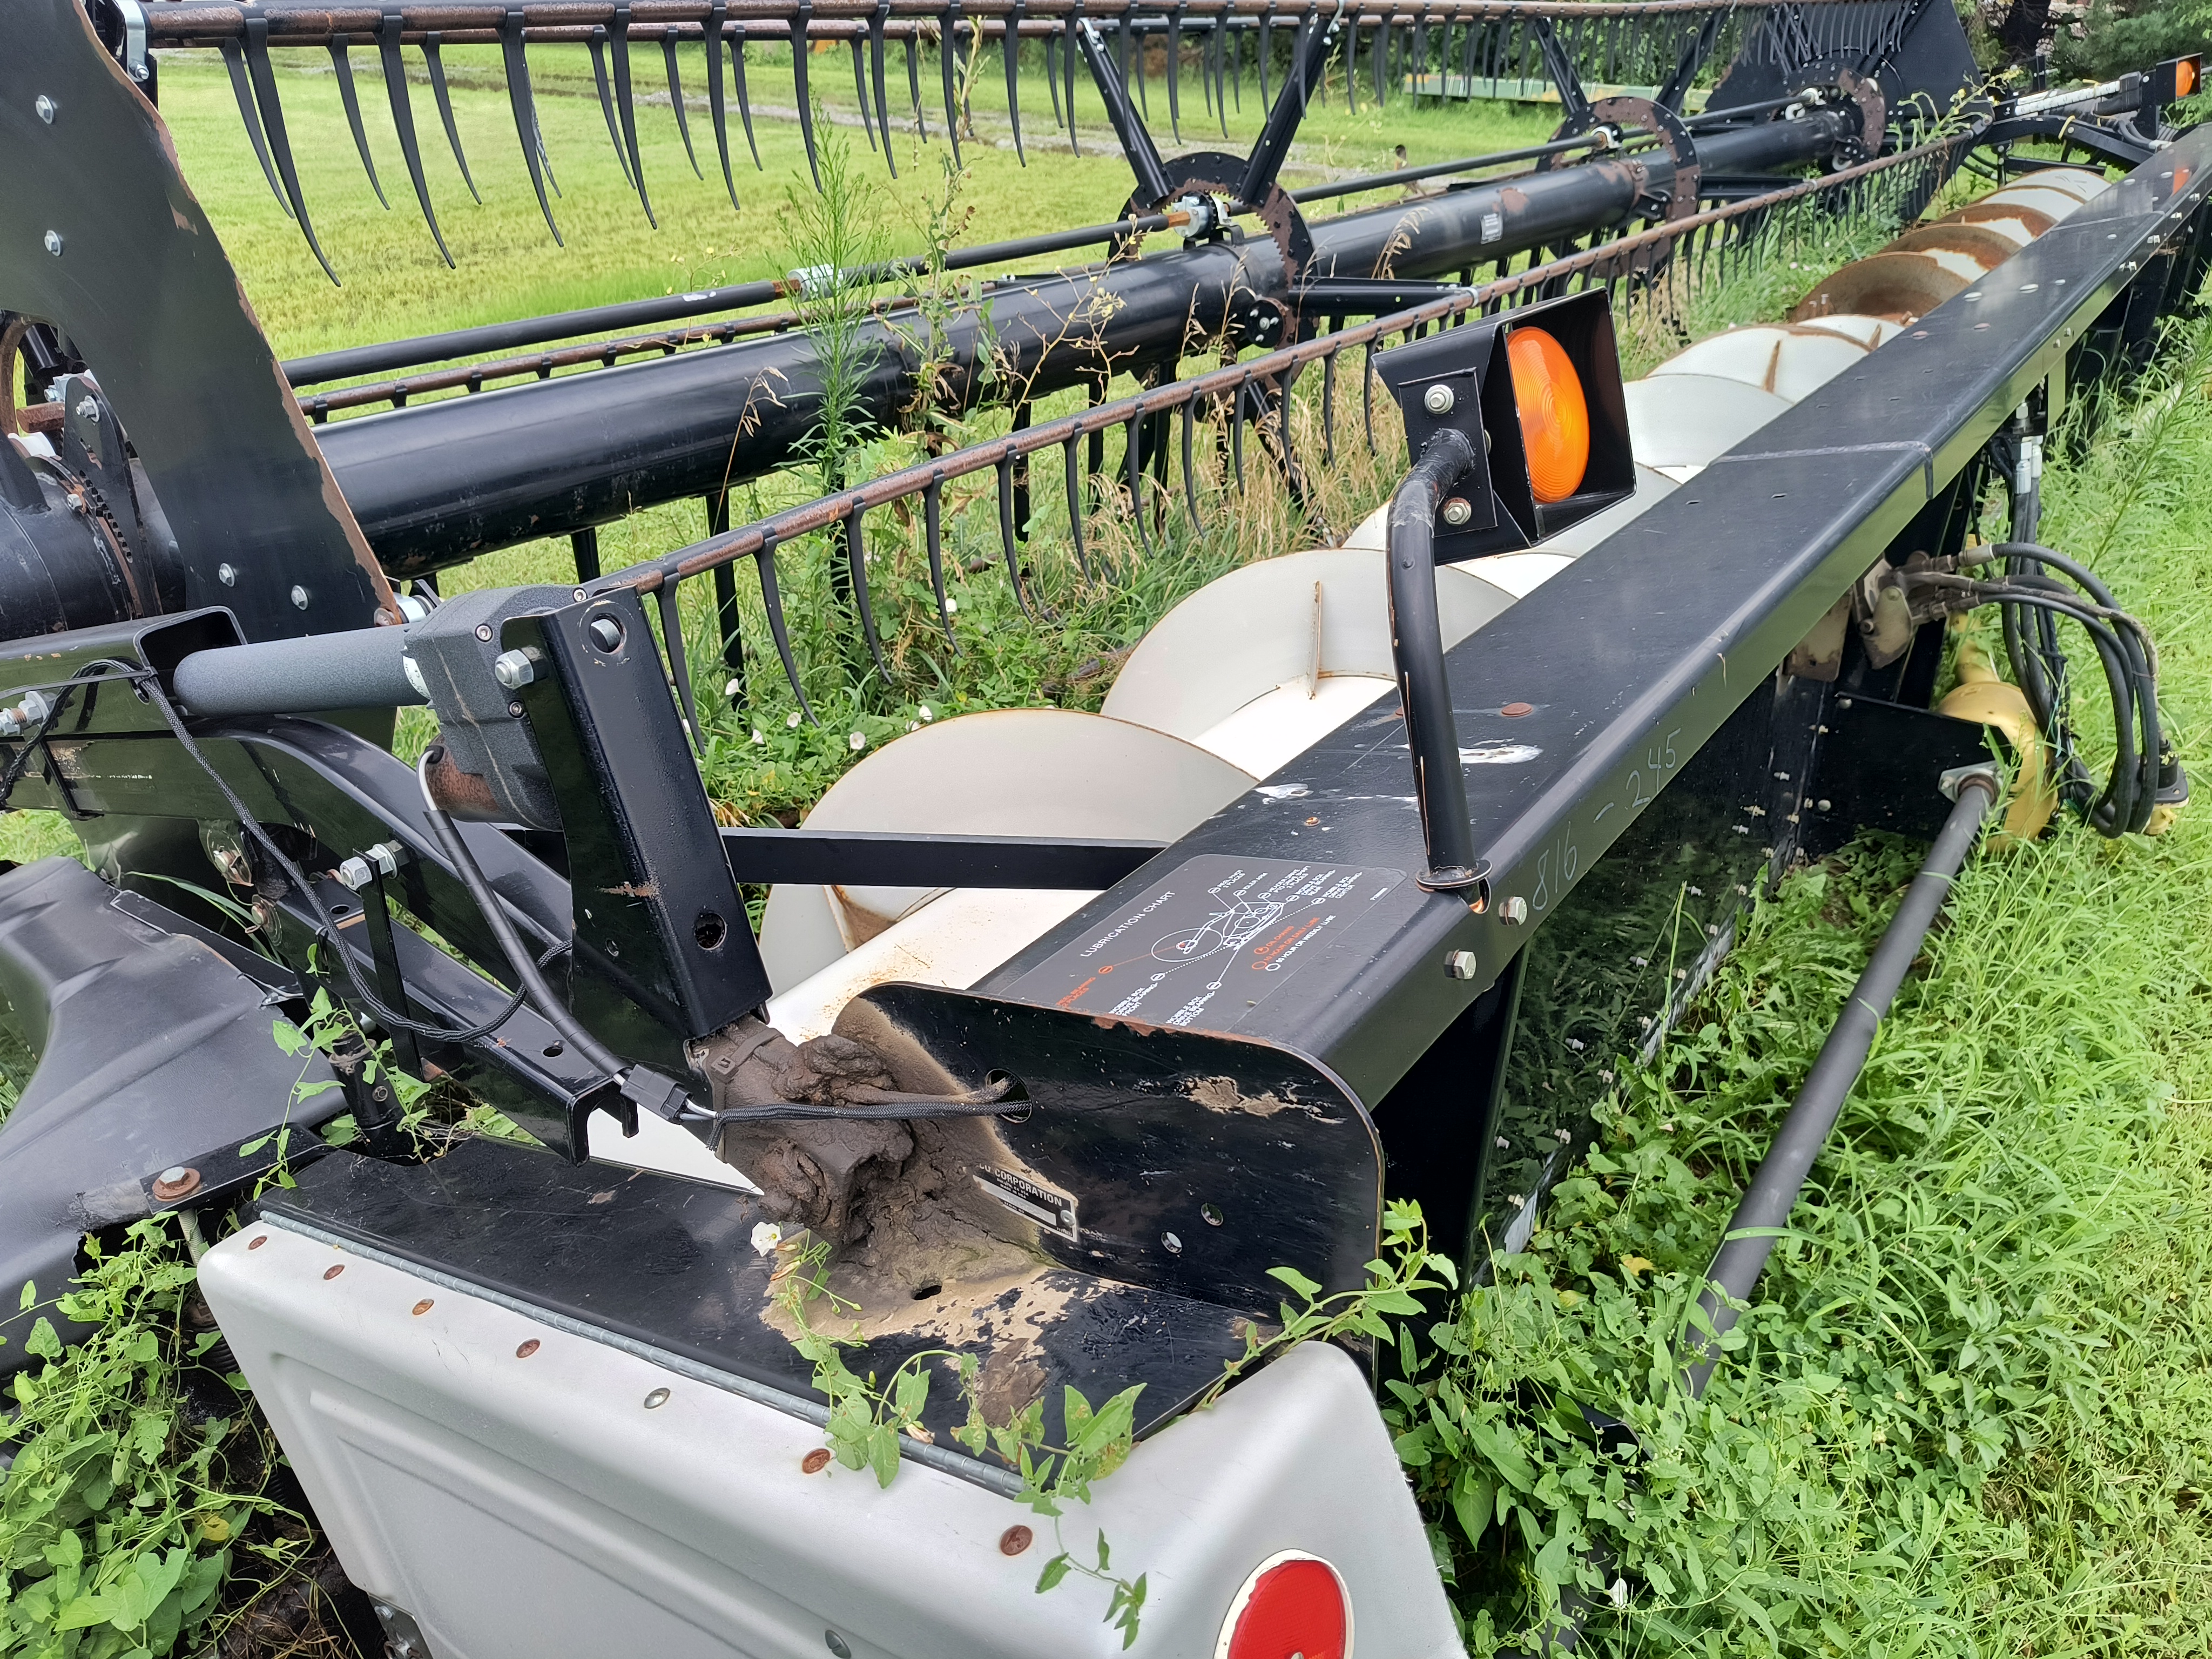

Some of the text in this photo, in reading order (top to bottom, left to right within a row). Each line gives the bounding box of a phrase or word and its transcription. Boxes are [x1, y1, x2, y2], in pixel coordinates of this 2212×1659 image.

[1533, 821, 1577, 911] 816
[1626, 727, 1681, 808] 245
[1080, 891, 1175, 957] LUBRICATION CHART
[1269, 943, 1287, 956] HOUR
[1291, 927, 1306, 939] DAILY
[1304, 916, 1320, 927] LUBE
[1281, 946, 1299, 958] HOUR
[1301, 925, 1323, 940] WEEKLY
[1320, 915, 1336, 925] LUBE
[1178, 1007, 1204, 1027] BOTTOM
[995, 1168, 1062, 1206] CORPORATION
[1000, 1183, 1011, 1191] MADE
